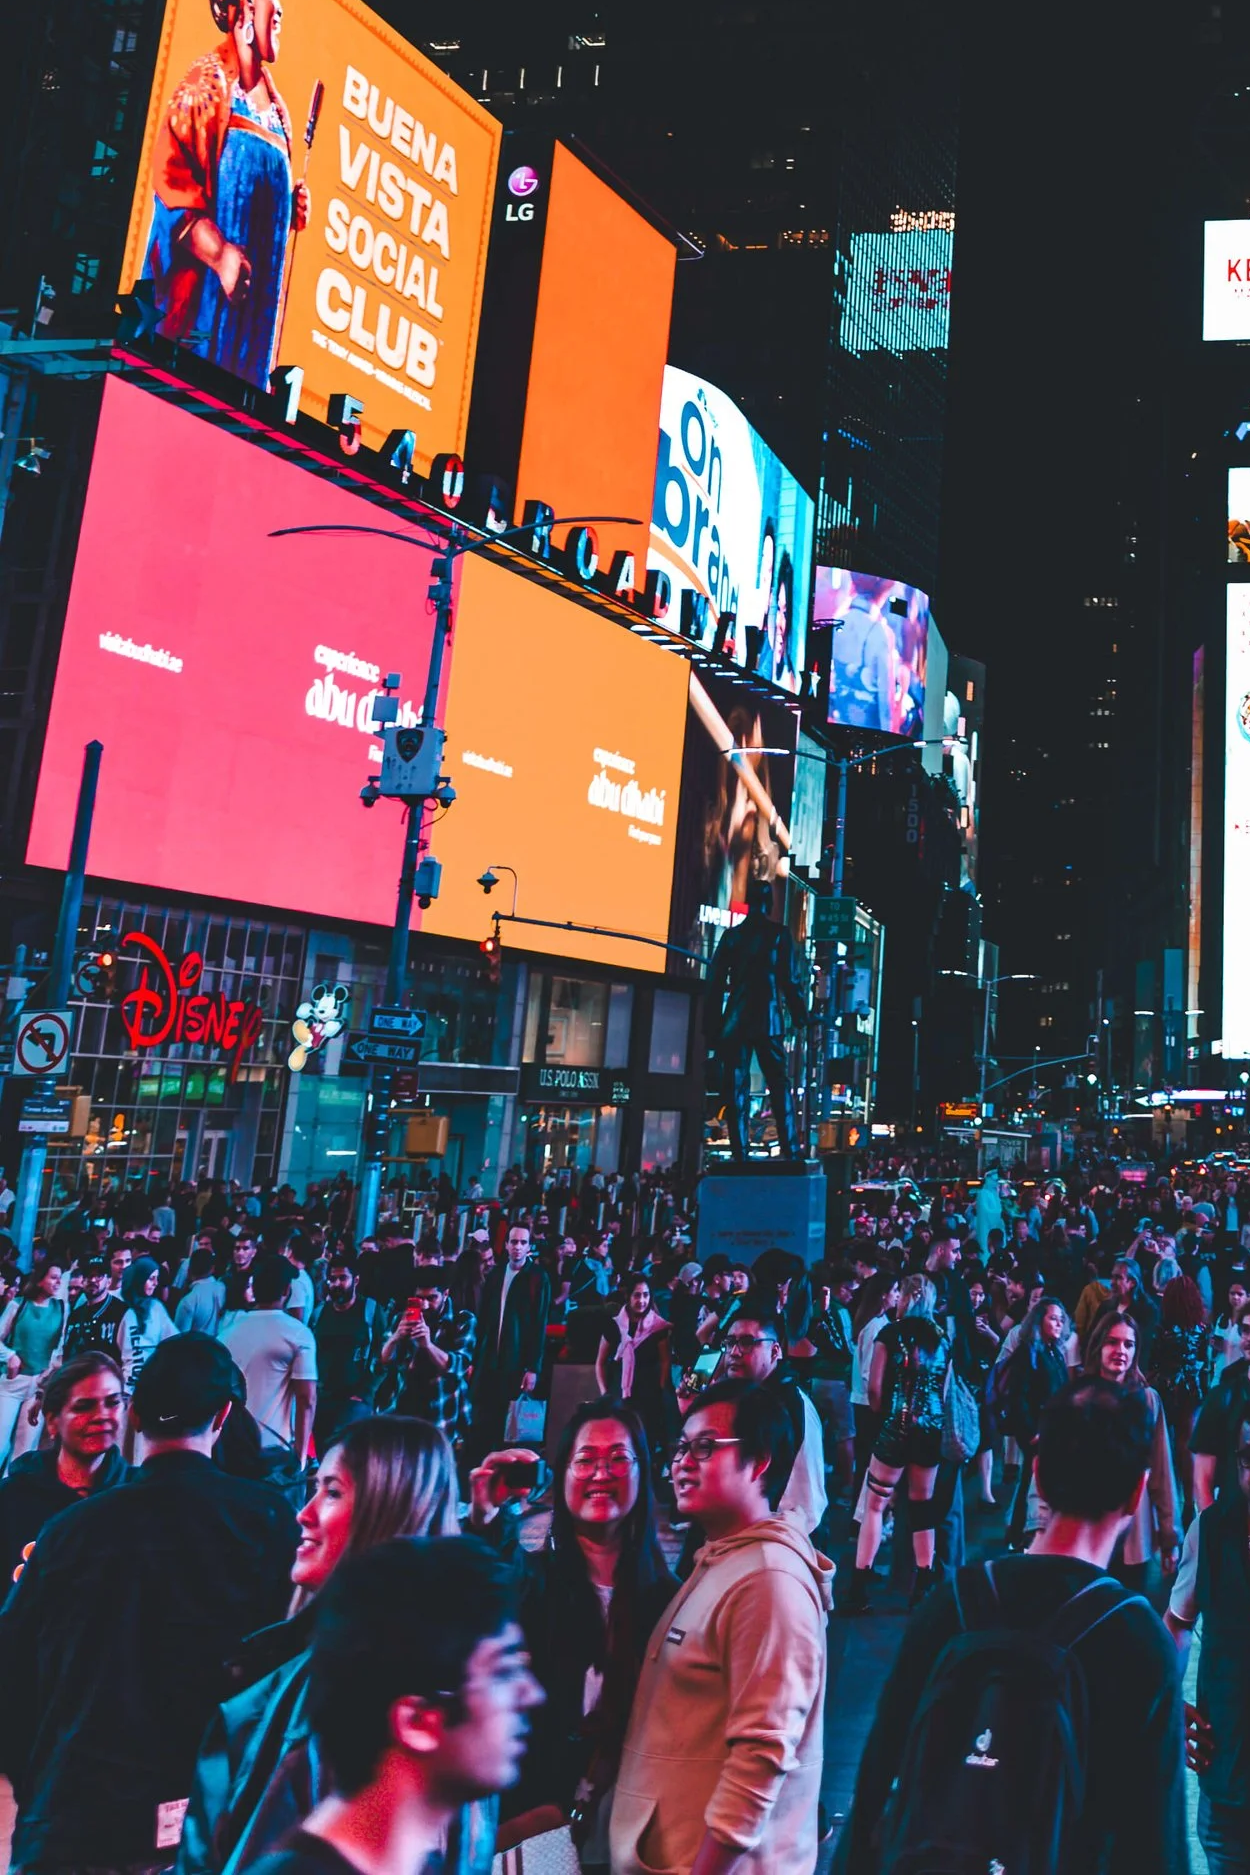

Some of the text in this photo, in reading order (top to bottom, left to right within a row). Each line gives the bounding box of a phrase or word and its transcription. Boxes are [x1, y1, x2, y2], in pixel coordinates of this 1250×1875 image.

[342, 65, 458, 197] BUENA
[339, 124, 450, 261] VISTA
[505, 203, 534, 222] LG
[325, 198, 443, 323] SOCIAL
[315, 267, 438, 389] CLUB
[284, 366, 465, 509] 1540
[681, 400, 722, 516] on
[314, 644, 381, 684] experience
[305, 672, 357, 728] abu
[587, 769, 666, 826] abu dhabi
[906, 784, 918, 843] 1500
[378, 1016, 419, 1028] ONE WAY
[357, 1043, 410, 1059] ONE WAY
[554, 1070, 577, 1087] POLO
[965, 1752, 999, 1767] deuter
